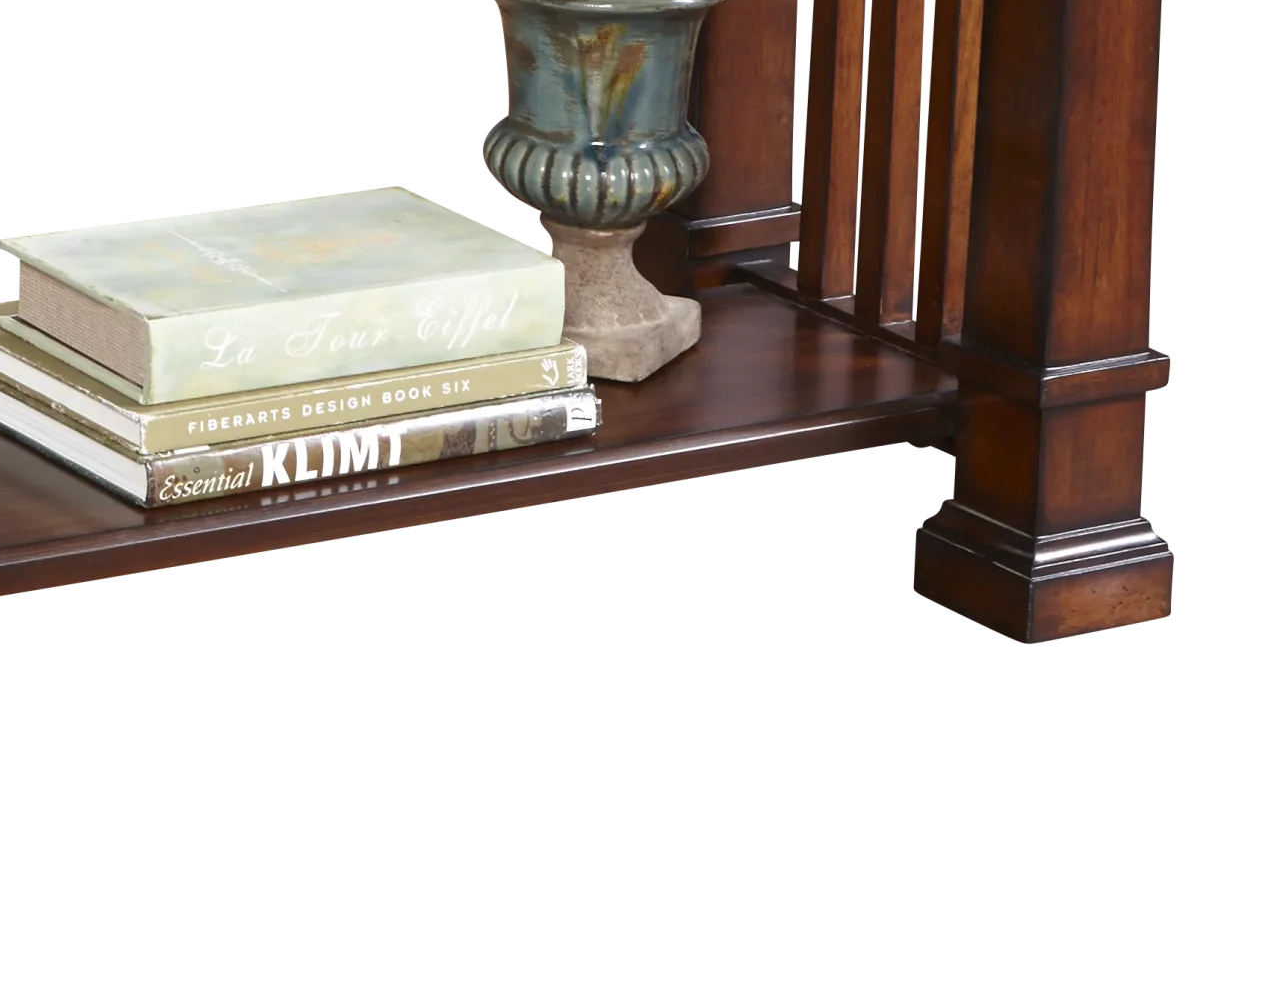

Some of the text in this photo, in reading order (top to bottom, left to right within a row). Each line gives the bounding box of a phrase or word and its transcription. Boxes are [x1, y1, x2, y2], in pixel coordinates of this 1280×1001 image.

[200, 293, 518, 370] La Tour Eiffel
[187, 379, 471, 434] FIBERARTS DESIGN BOOK SIX
[159, 426, 407, 501] Essential KLIMT
